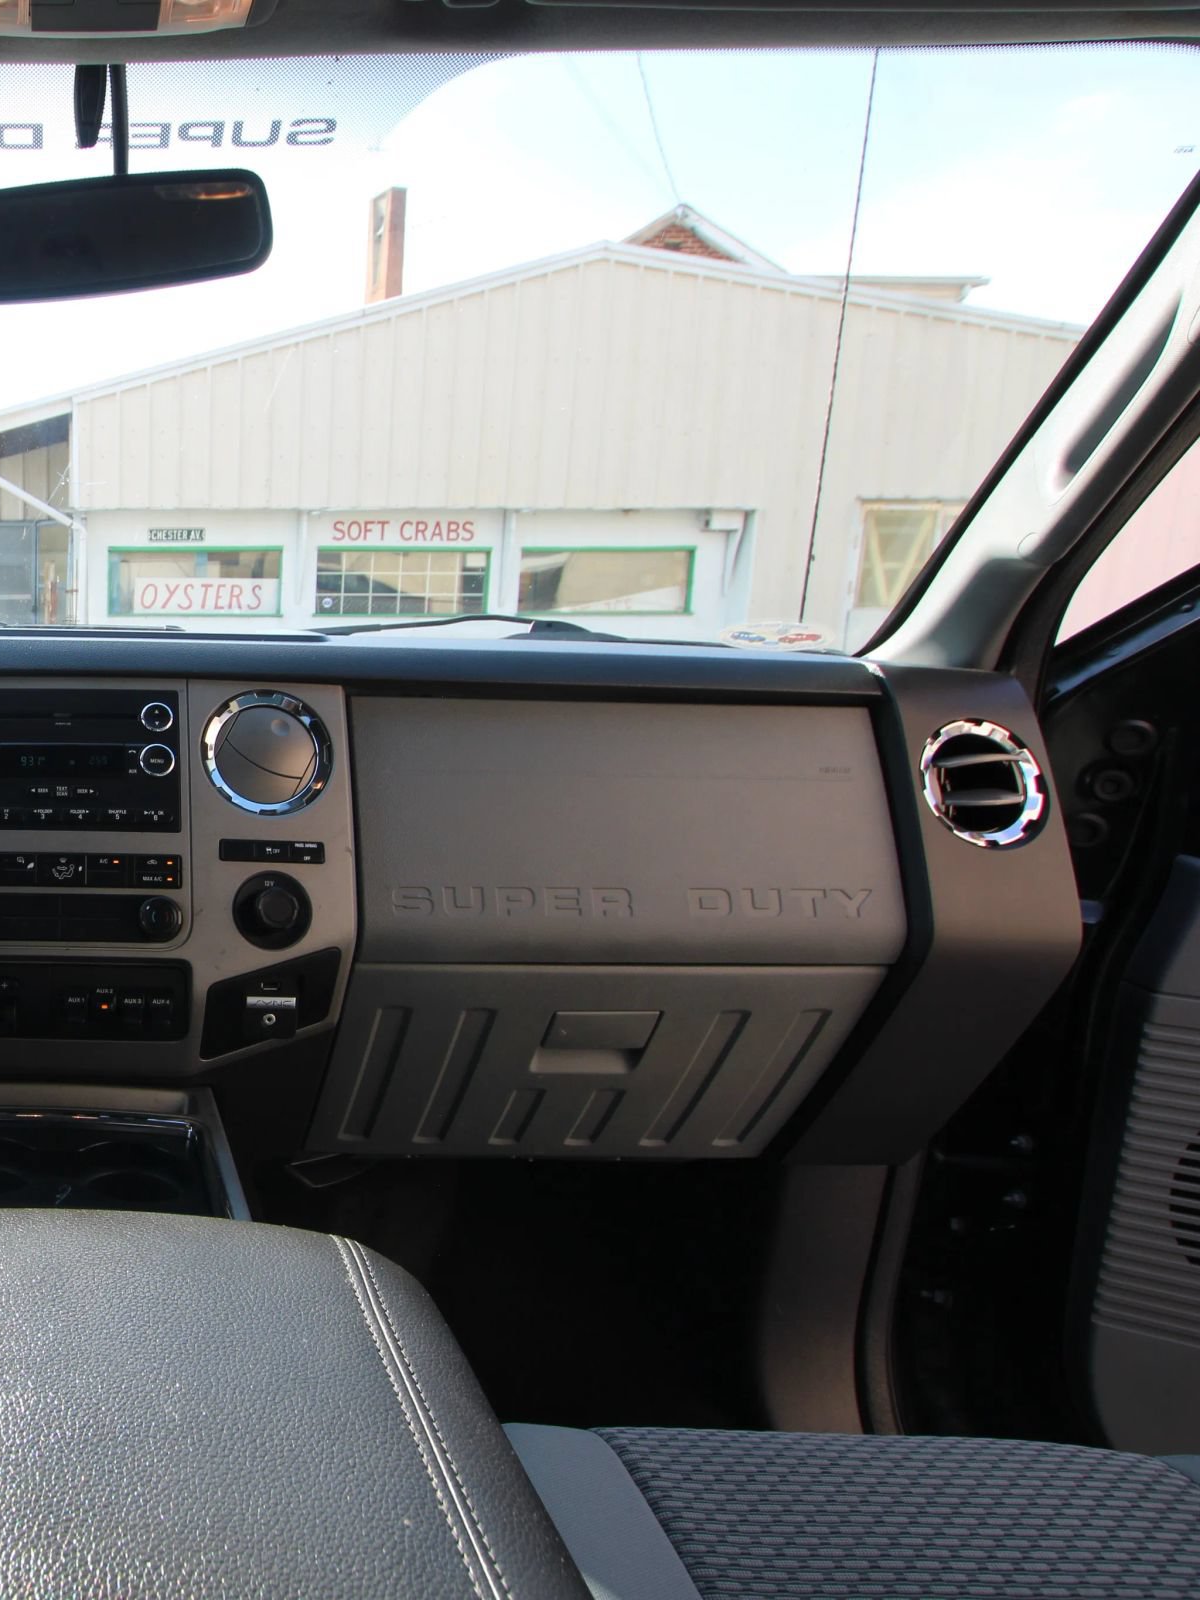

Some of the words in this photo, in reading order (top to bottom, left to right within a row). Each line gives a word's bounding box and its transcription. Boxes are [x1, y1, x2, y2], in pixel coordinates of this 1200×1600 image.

[151, 529, 188, 540] CHESTER
[332, 520, 390, 541] SOFT
[400, 520, 475, 542] CRABS
[140, 582, 263, 611] OYSTERS
[391, 885, 634, 919] SUPER
[688, 887, 874, 919] DUTY
